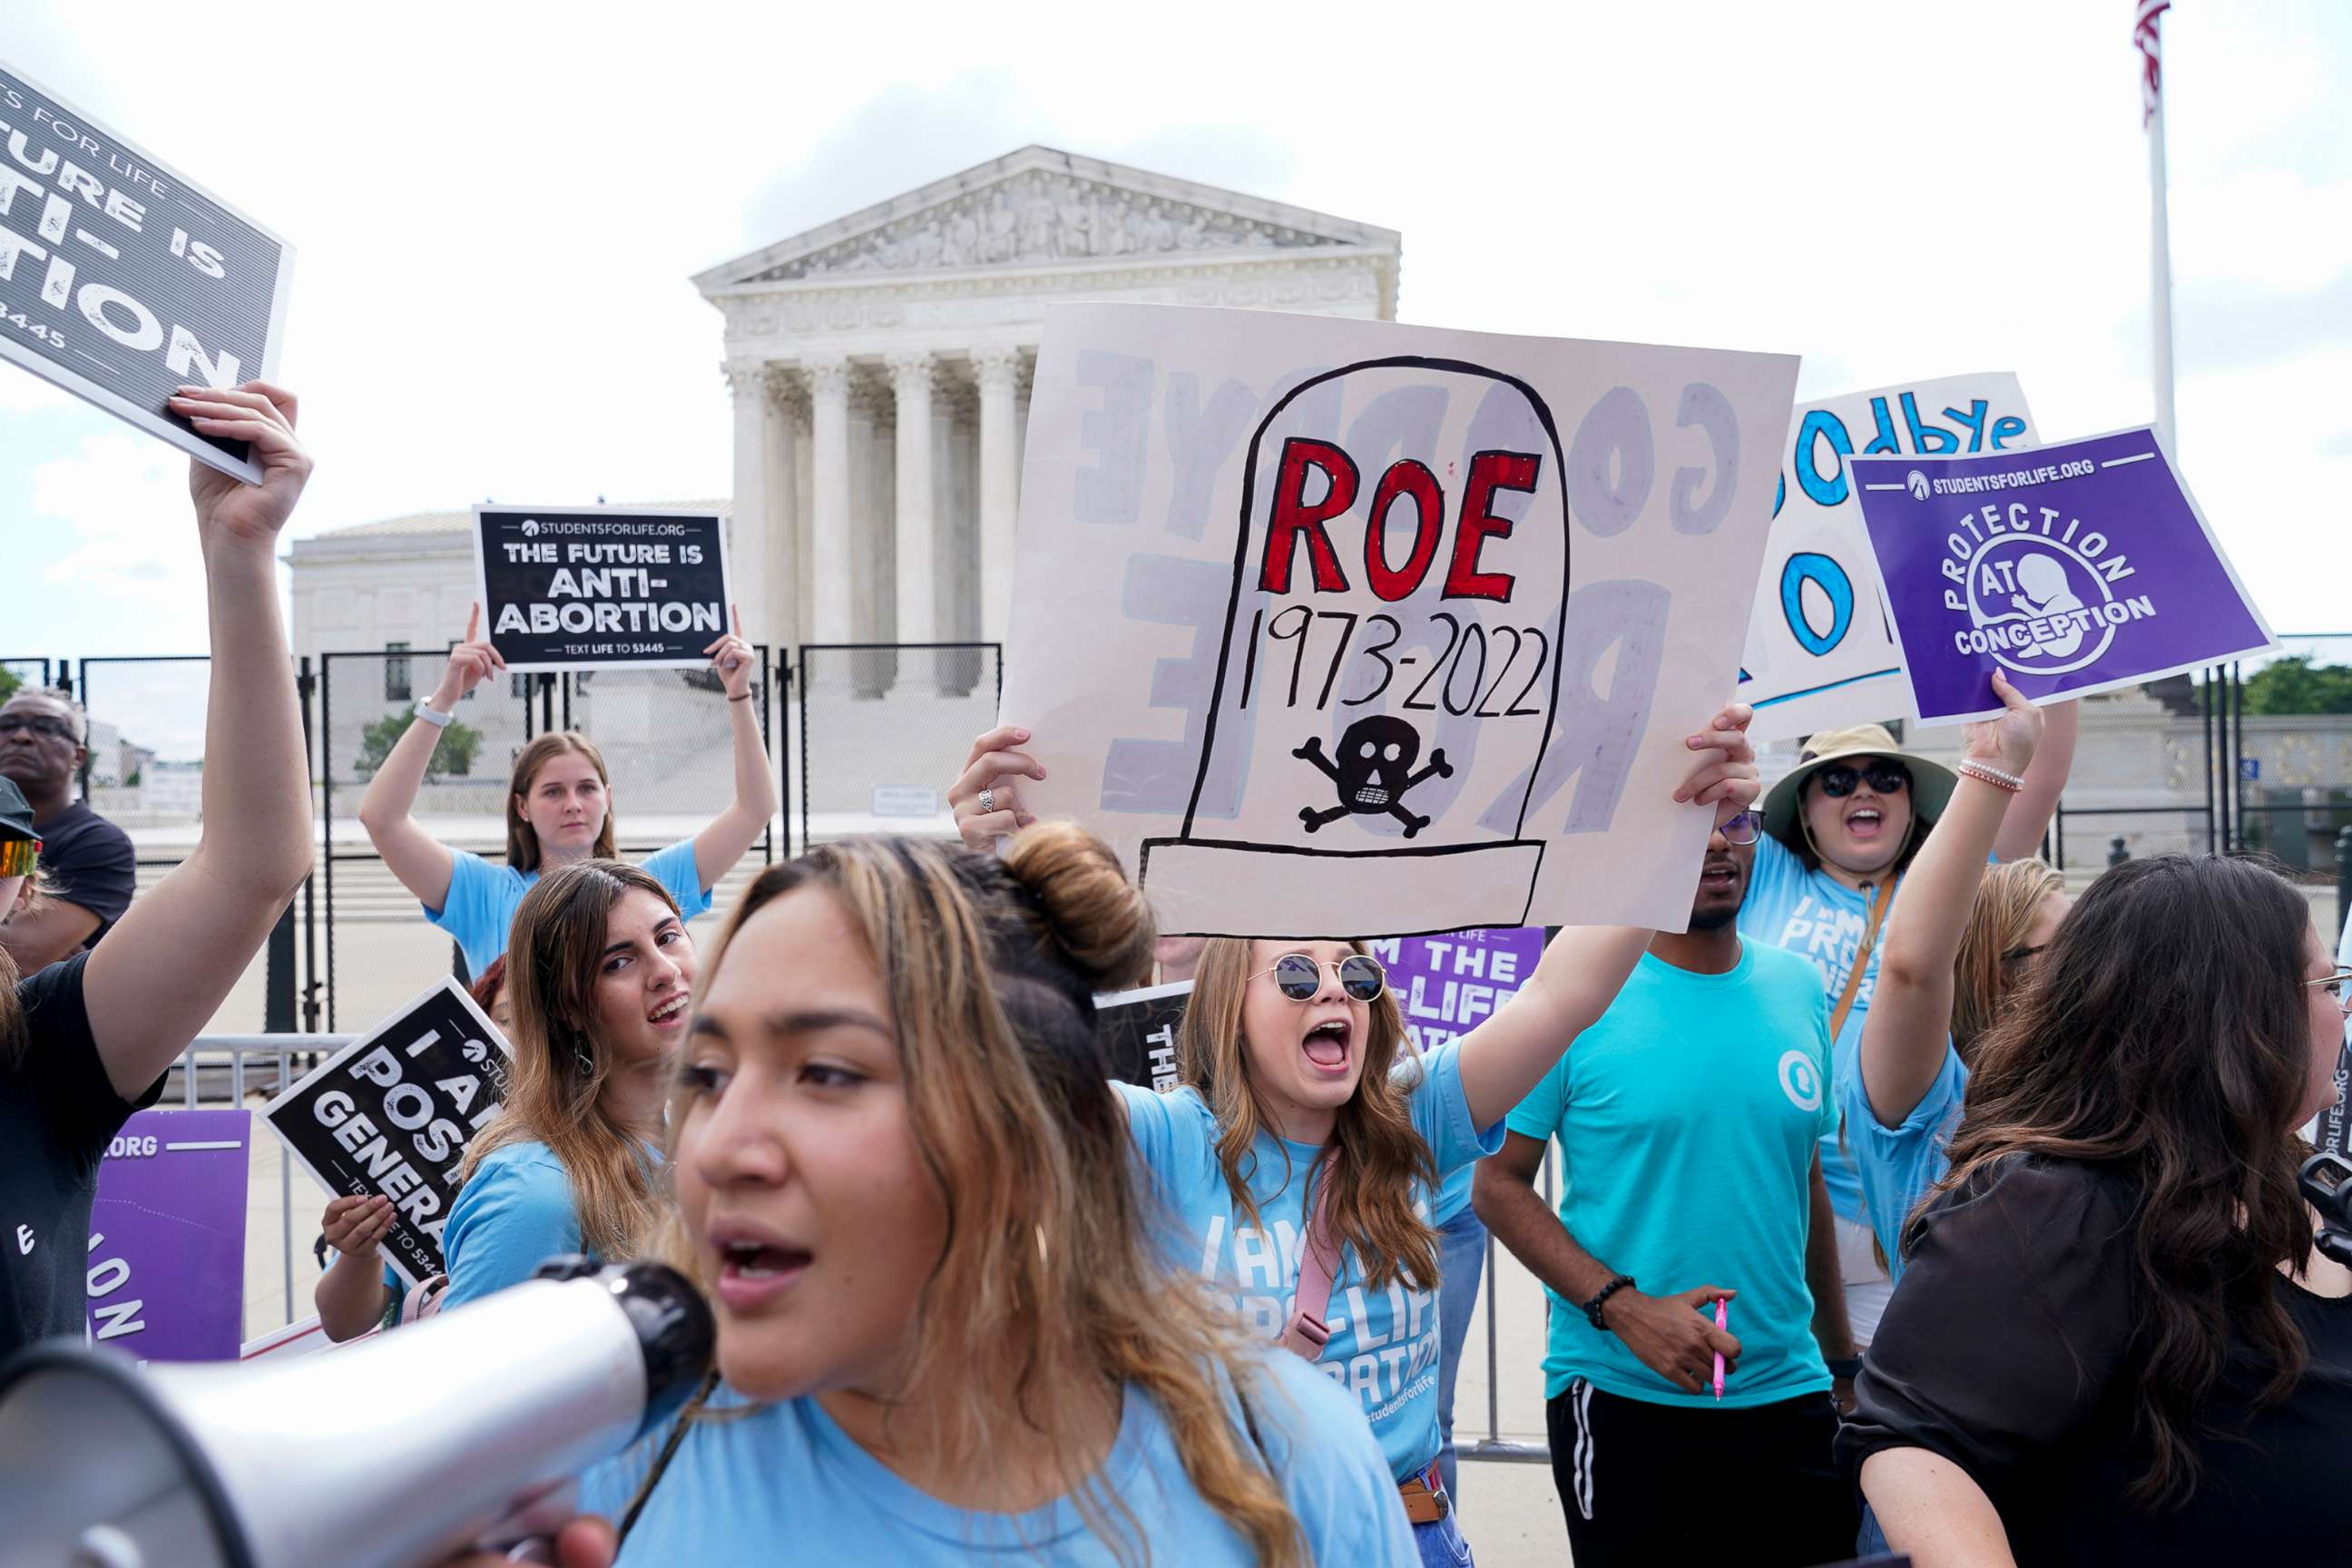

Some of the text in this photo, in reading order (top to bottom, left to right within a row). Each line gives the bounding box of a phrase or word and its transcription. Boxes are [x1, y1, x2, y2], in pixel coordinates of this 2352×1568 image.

[34, 107, 100, 158] FOR
[109, 154, 167, 200] LIFE
[170, 227, 225, 279] IS
[1933, 458, 2095, 496] STUDENTSFORLIFE.ORG
[541, 522, 686, 536] STUDENTSFORLIFE.ORG
[1256, 436, 1543, 604] ROE
[503, 543, 704, 564] THE FUTURE IS
[1941, 502, 2136, 612] PROTECTION
[547, 567, 668, 599] ANTI-
[1980, 560, 2017, 597] AT
[494, 602, 721, 635] ABORTION
[1954, 594, 2158, 656] CONCEPTION
[564, 642, 665, 656] TEXT LIFE TO 53445
[1239, 603, 1549, 718] 1973-2022
[1424, 939, 1518, 984] THE
[405, 1029, 441, 1058] I
[397, 1230, 415, 1250] TO
